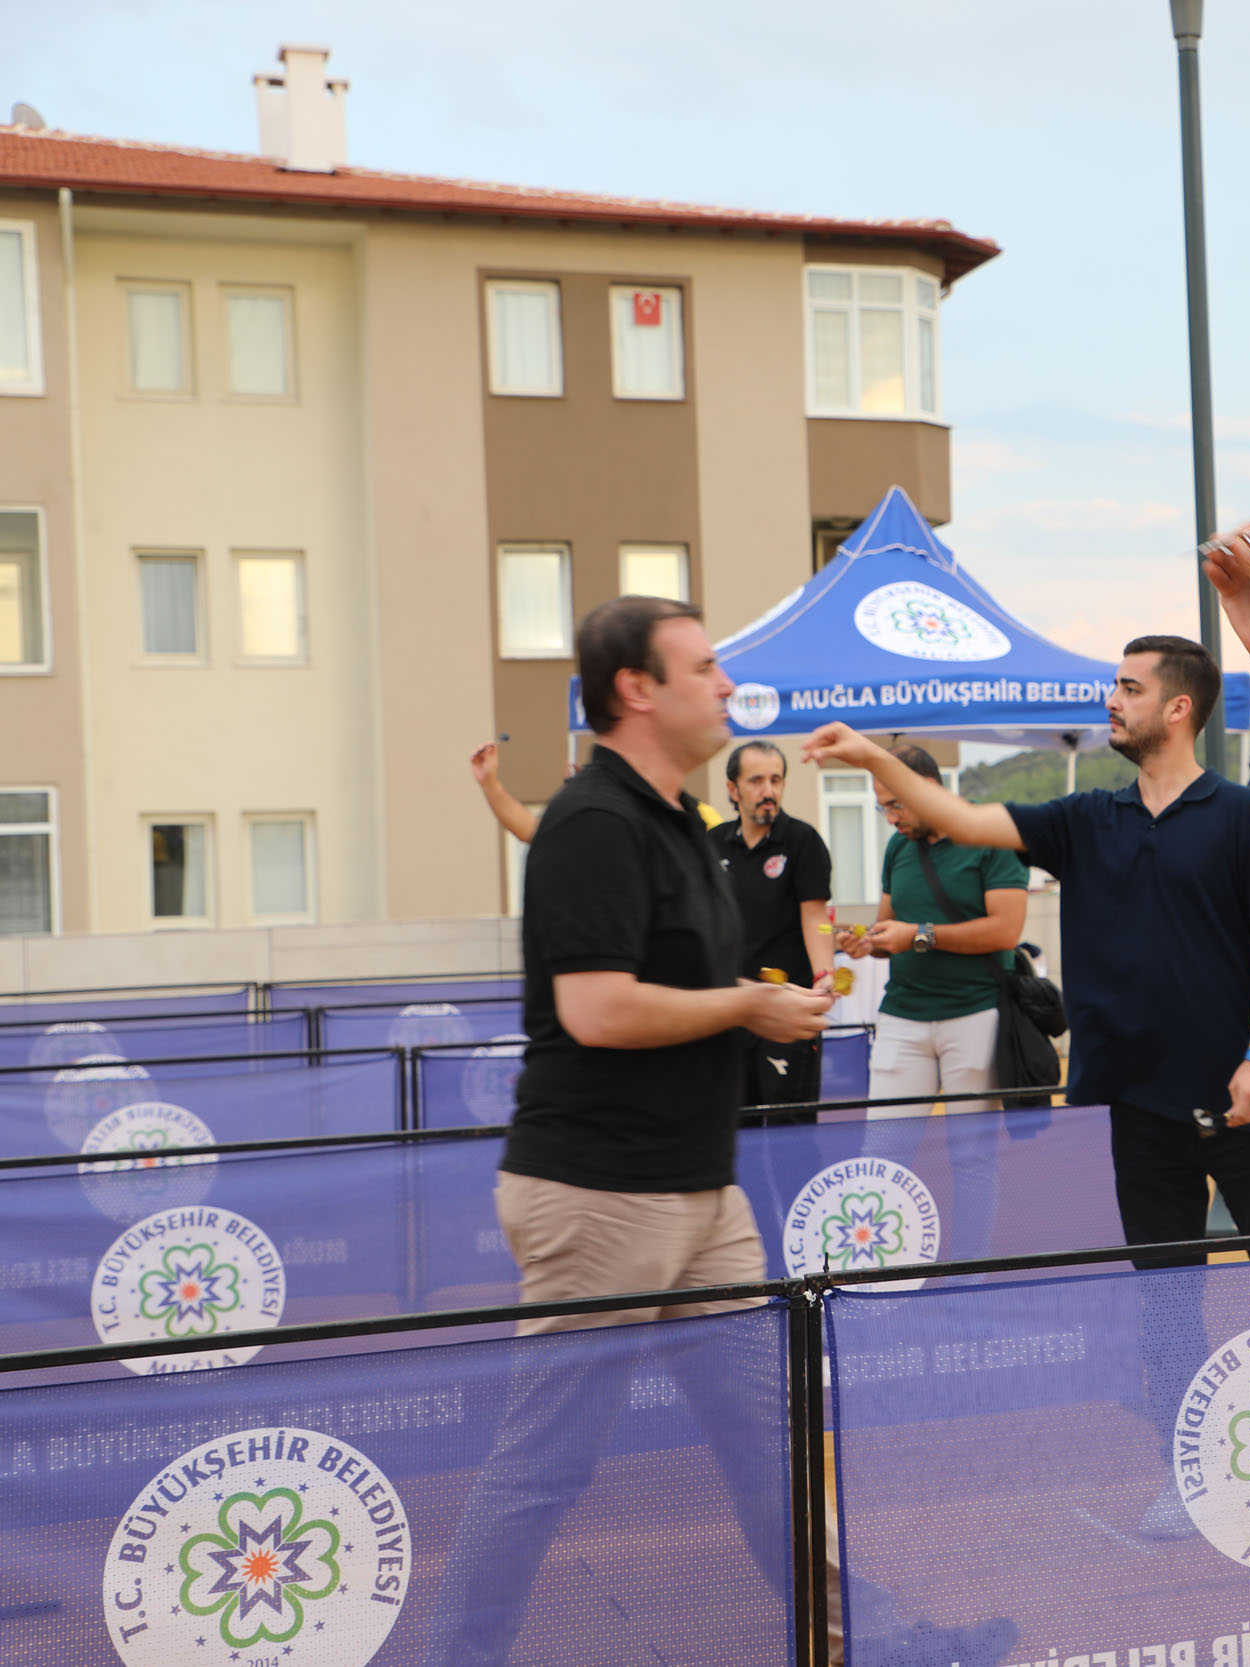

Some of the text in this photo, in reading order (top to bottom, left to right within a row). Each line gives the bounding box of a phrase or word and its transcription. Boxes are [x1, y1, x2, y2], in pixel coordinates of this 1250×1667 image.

[791, 684, 877, 710] MUĞLA
[881, 678, 1023, 707] BÜYÜKŞEHİR
[101, 1208, 219, 1287] BÜYÜKŞEHİR
[791, 1160, 887, 1230] BÜYÜKŞEHİR
[891, 1170, 937, 1260] BELEDİYESİ
[225, 1219, 281, 1318] BELEDİYESİ
[98, 1296, 120, 1334] T.C.
[114, 1430, 407, 1644] T.C. BÜYÜKŞEHİR BELEDİYESİ
